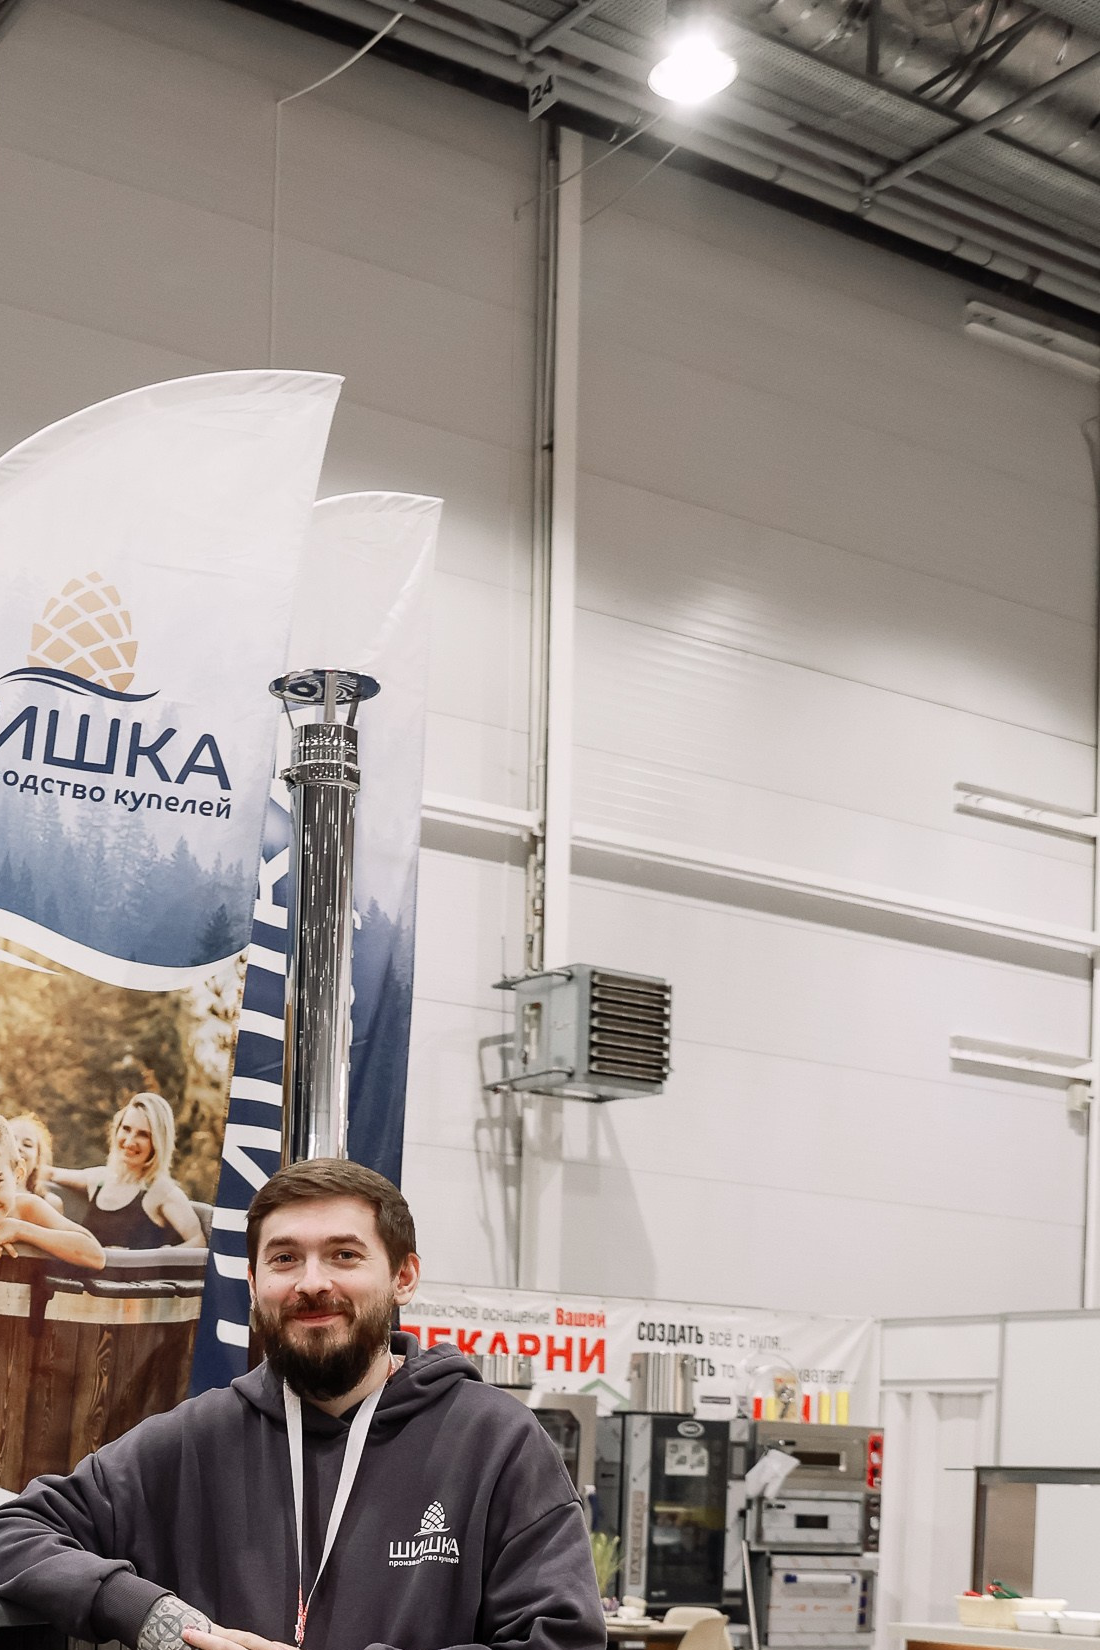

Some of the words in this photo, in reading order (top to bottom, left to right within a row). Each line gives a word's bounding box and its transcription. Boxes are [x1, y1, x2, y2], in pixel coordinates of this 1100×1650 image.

[531, 75, 553, 108] 24
[114, 788, 232, 819] купелей
[400, 1302, 478, 1320] омплексное
[556, 1307, 606, 1328] Вашей
[638, 1322, 703, 1346] СОЗДАТЬ
[388, 1536, 460, 1558] ШИШКА
